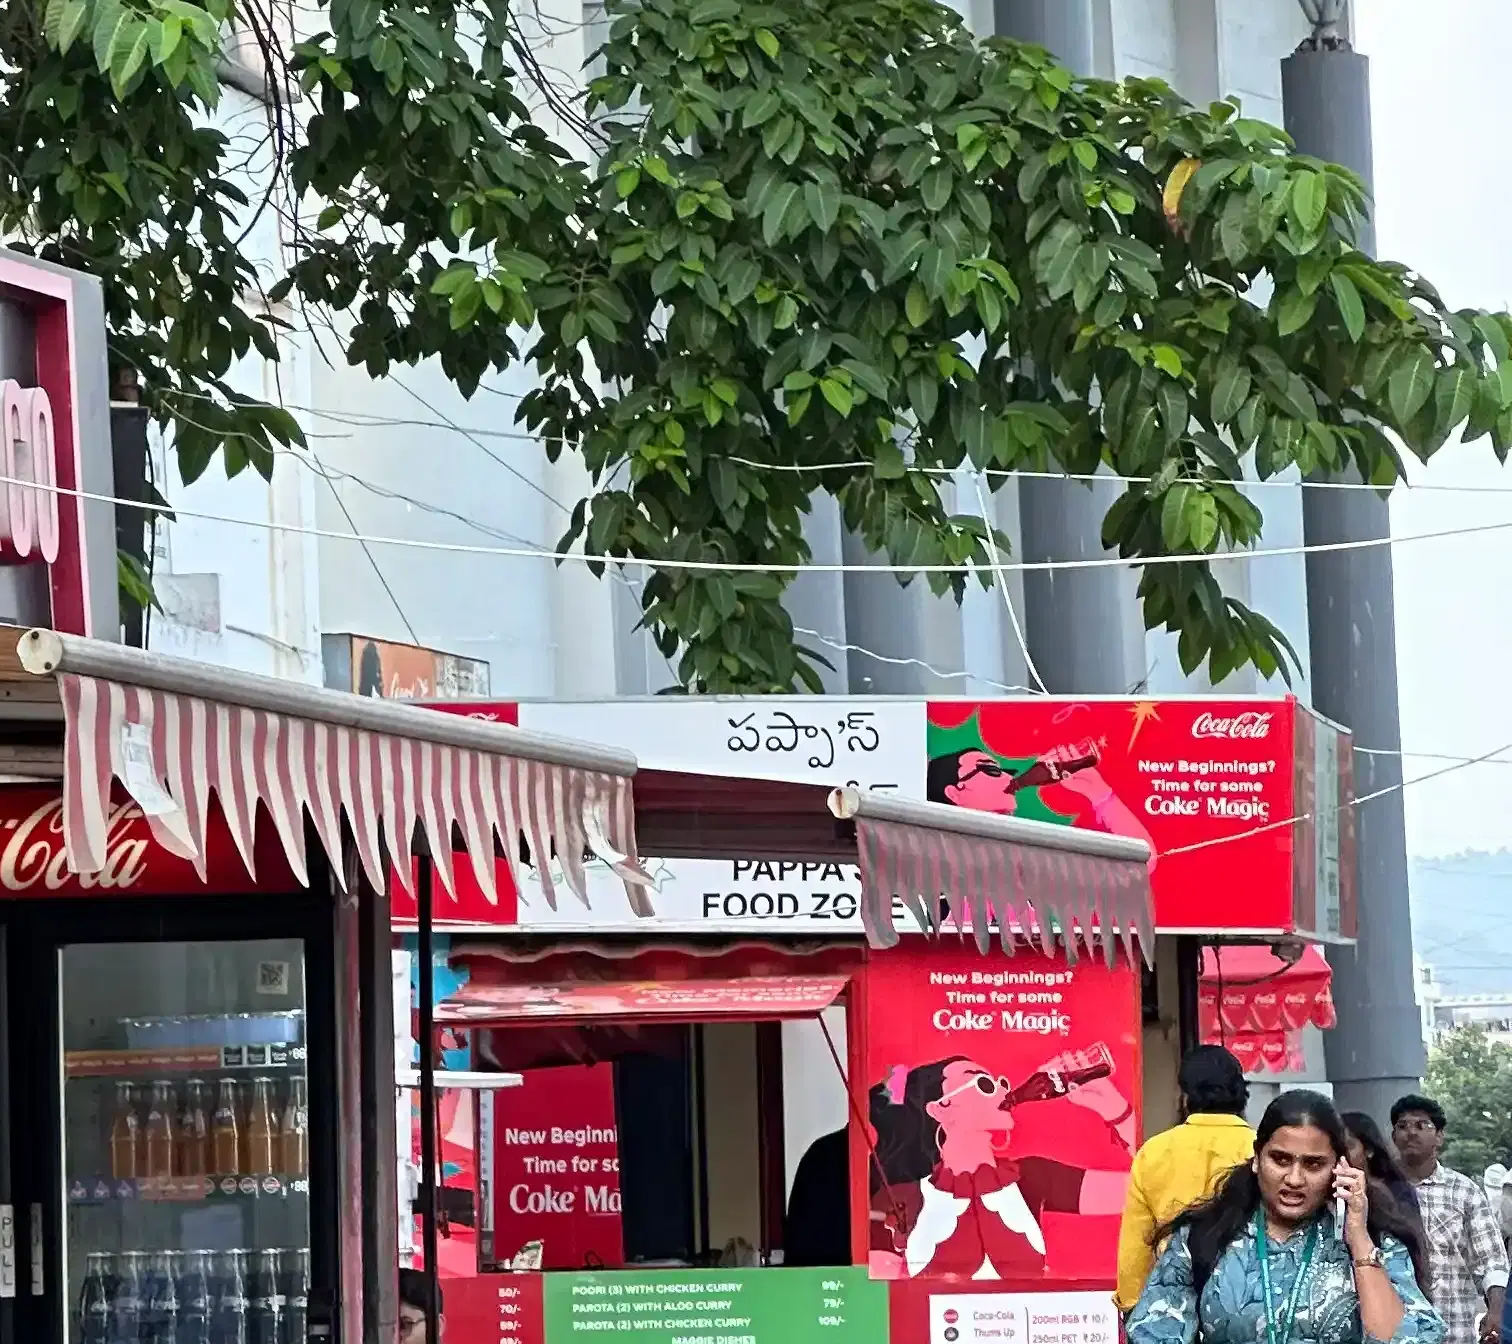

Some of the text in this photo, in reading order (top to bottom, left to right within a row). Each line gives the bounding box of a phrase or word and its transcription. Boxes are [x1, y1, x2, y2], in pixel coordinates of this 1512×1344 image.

[1138, 759, 1276, 775] New Beginnings?
[1151, 779, 1263, 792] Time for some
[1144, 795, 1270, 821] Coke Magic
[702, 892, 906, 919] FOOD ZOE
[930, 971, 1074, 987] New Beginnings?
[946, 991, 1062, 1004] Time for some
[933, 1009, 1072, 1035] Coke Magic
[505, 1127, 547, 1145] New
[523, 1156, 567, 1173] Time
[571, 1155, 598, 1173] for
[509, 1183, 575, 1214] Coke
[572, 1285, 606, 1296] POORI
[625, 1284, 653, 1294] WITH
[656, 1283, 704, 1294] CHICKEN
[706, 1282, 743, 1293] CURRY
[572, 1302, 615, 1313] PAROTA
[633, 1301, 661, 1312] WITH
[664, 1301, 693, 1311] ALOO
[696, 1300, 731, 1311] CURRY
[973, 1311, 1015, 1321] Coca-Cola
[573, 1320, 615, 1331] PAROTA
[634, 1320, 662, 1329] WITH
[664, 1319, 713, 1329] CHICKEN
[715, 1318, 751, 1328] CURRY
[1003, 1328, 1015, 1339] Up
